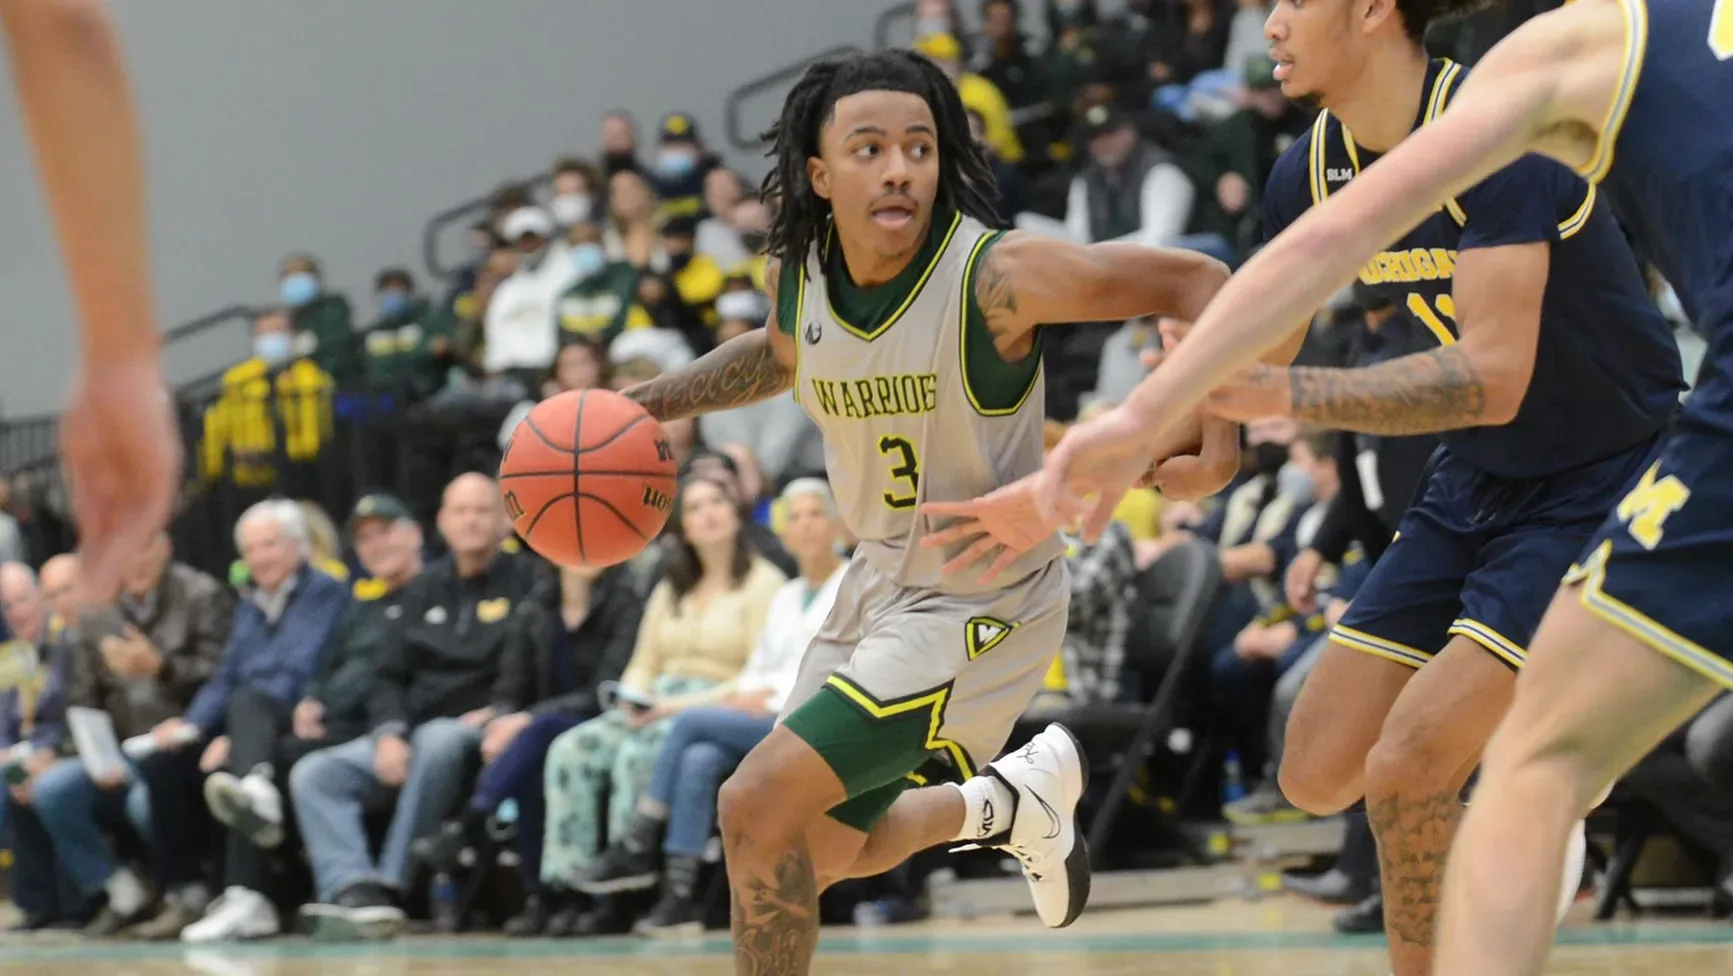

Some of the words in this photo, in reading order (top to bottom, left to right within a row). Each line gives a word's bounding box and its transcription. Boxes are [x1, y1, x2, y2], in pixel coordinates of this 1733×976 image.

[1326, 168, 1353, 182] BLM
[1358, 247, 1459, 285] ICHIGA
[878, 435, 920, 511] 3
[1616, 458, 1691, 551] M
